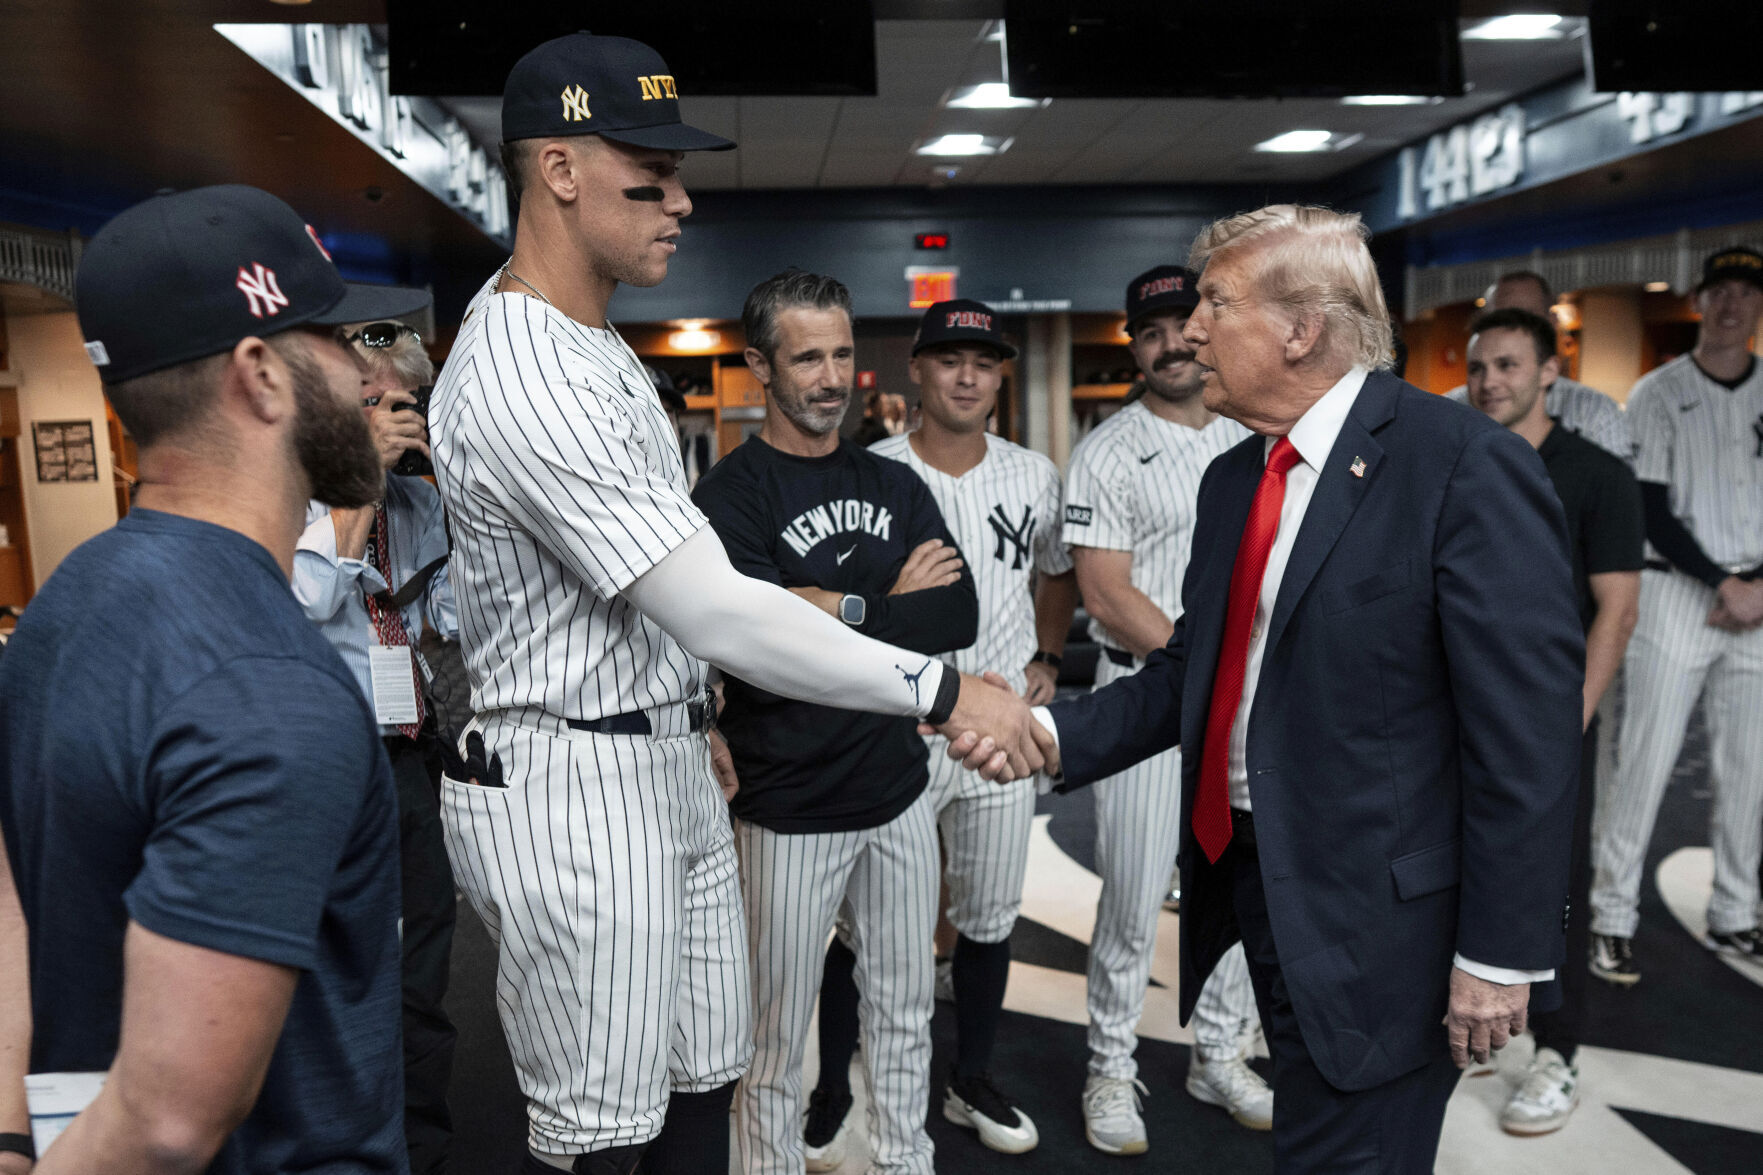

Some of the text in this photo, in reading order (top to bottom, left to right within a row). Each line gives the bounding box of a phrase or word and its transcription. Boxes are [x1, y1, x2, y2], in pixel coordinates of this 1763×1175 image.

[560, 83, 592, 122] NY
[637, 75, 679, 101] NY
[236, 260, 290, 320] NY
[945, 310, 993, 331] FDNY
[780, 498, 893, 558] NEW YORK
[987, 503, 1036, 570] NY
